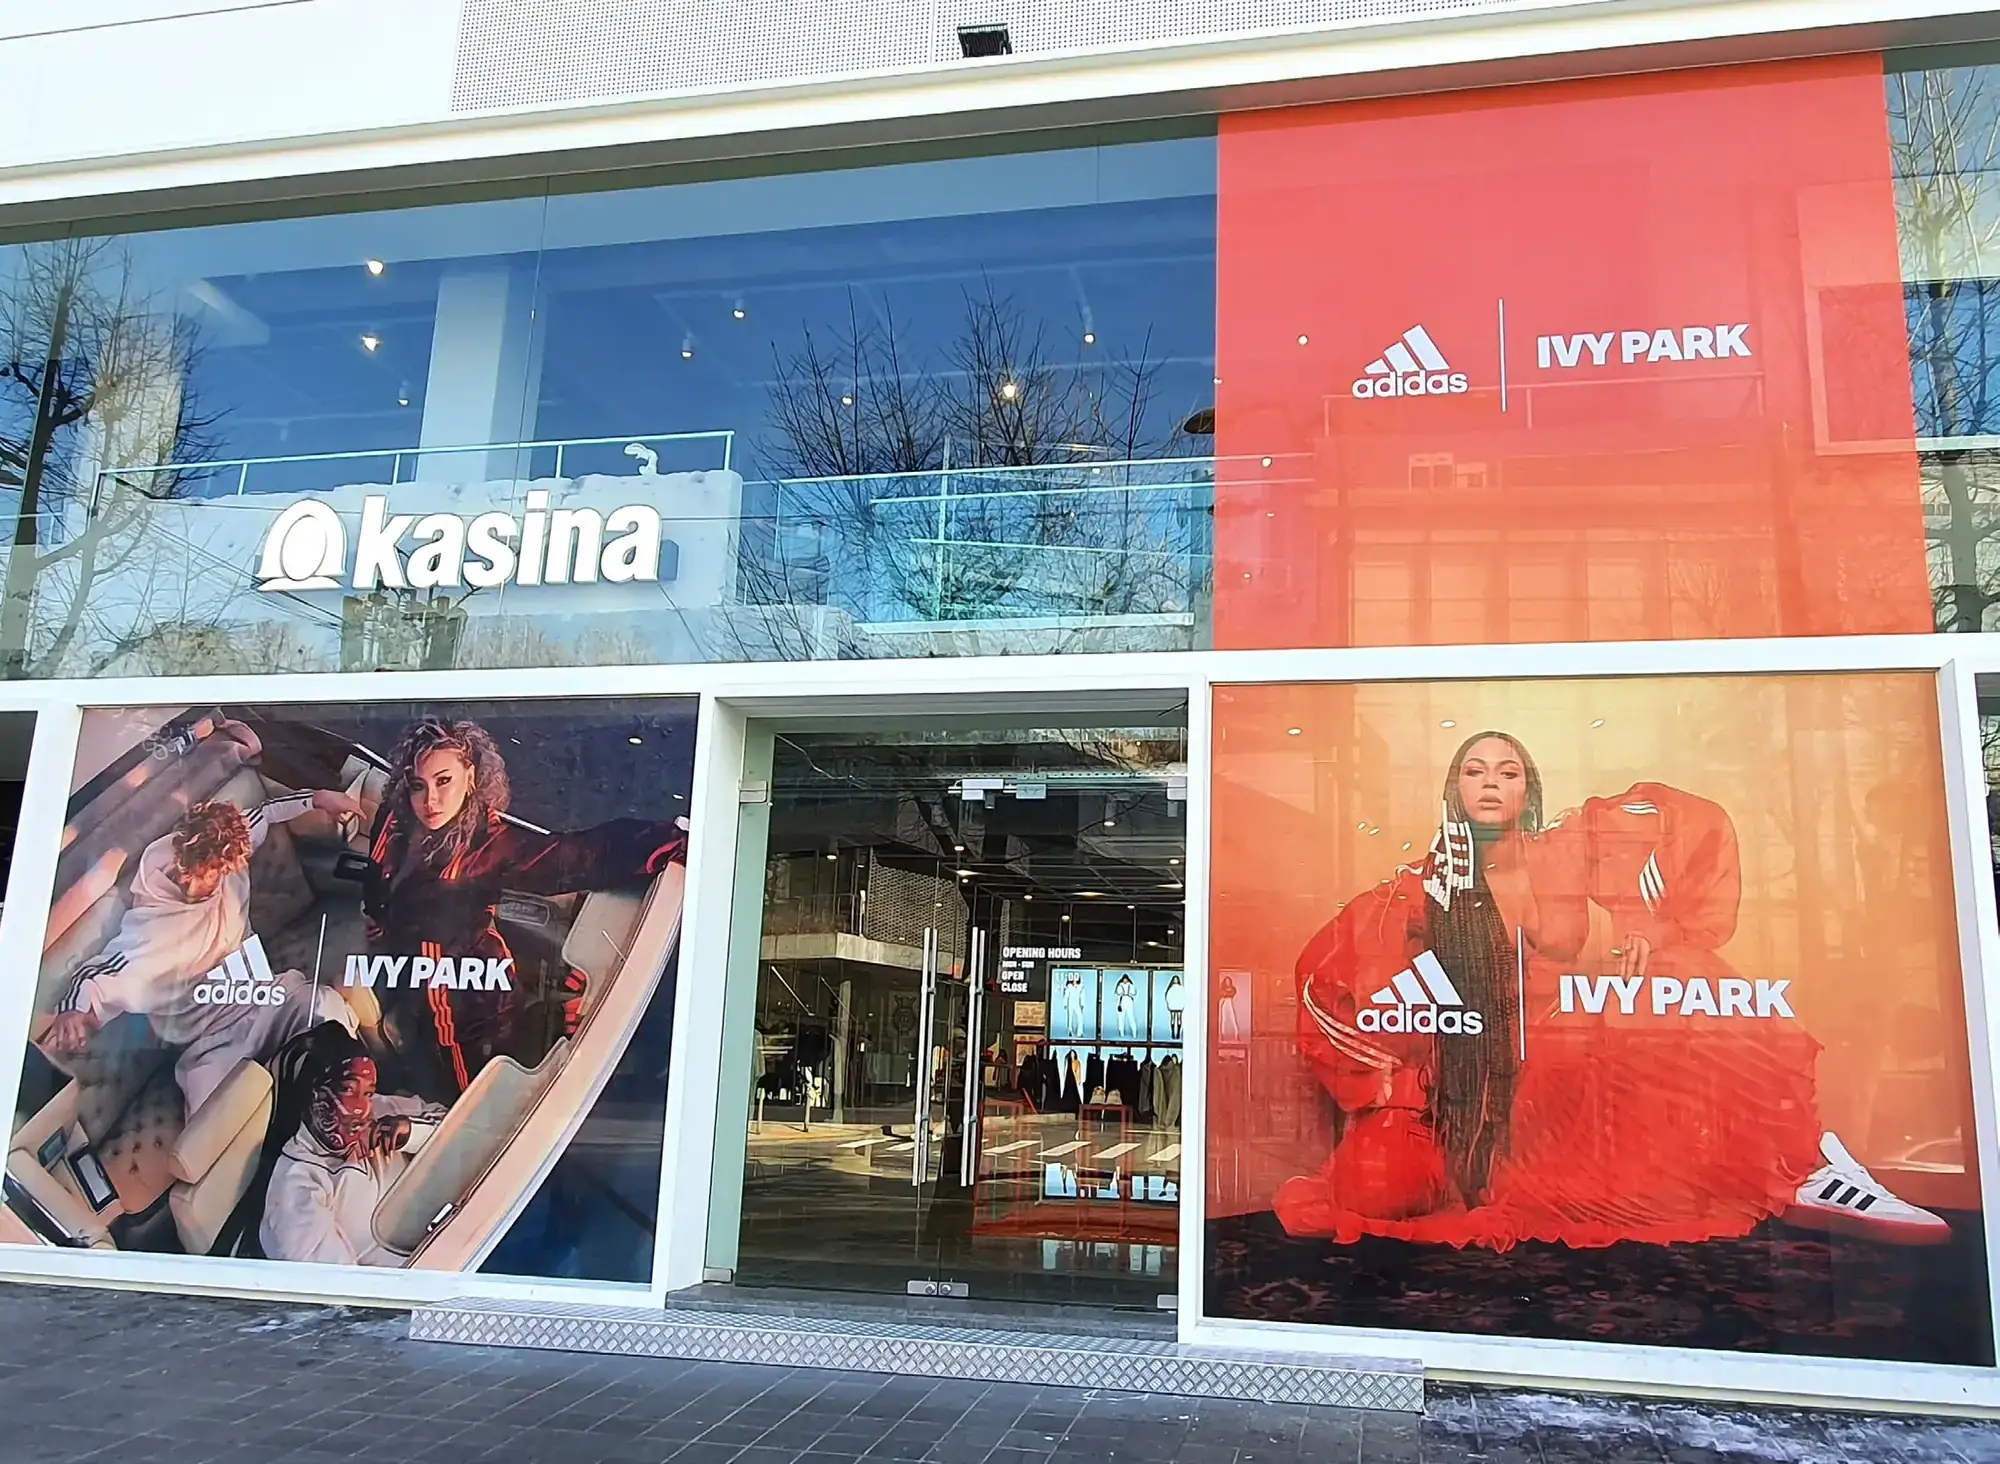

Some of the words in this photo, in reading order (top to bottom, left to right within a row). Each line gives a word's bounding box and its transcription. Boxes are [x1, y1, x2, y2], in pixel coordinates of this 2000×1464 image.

[1537, 333, 1615, 369] IVY
[1621, 323, 1753, 364] PARK
[1352, 371, 1469, 399] adidas
[354, 489, 661, 591] kasina
[1003, 946, 1046, 958] OPENING
[1047, 947, 1081, 959] HOURS
[344, 955, 409, 987] IVY
[410, 957, 513, 991] PARK
[1001, 971, 1024, 980] OPEN
[1001, 982, 1027, 992] CLOSE
[193, 979, 286, 1006] adidas
[1559, 975, 1644, 1014] IVY
[1651, 977, 1795, 1018] PARK
[1357, 1004, 1483, 1035] adidas
